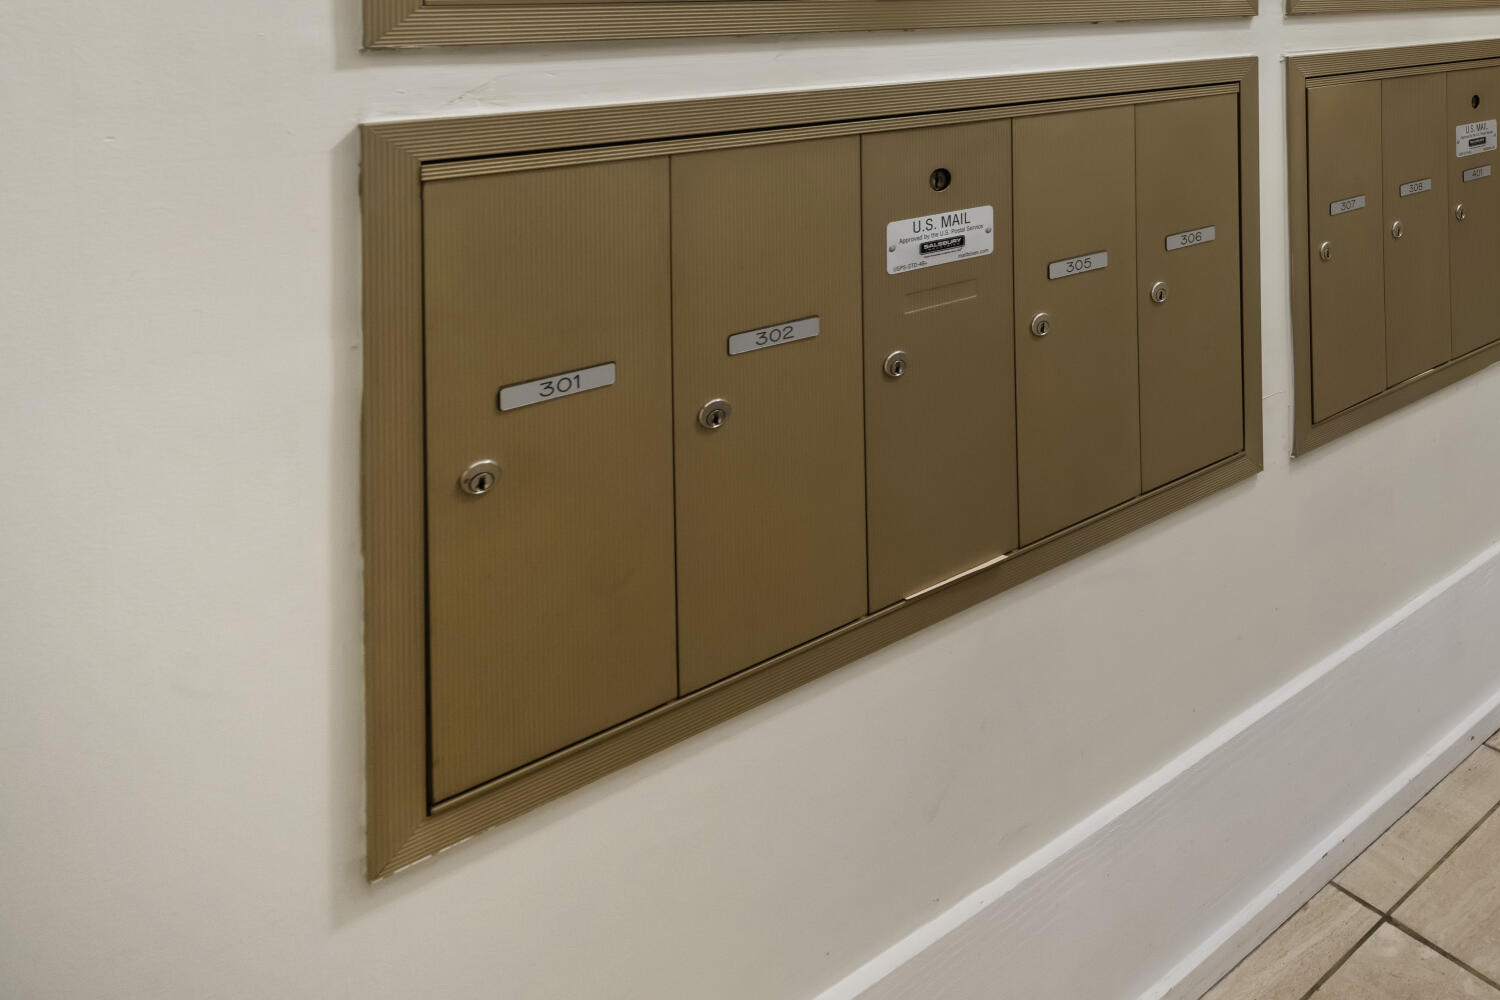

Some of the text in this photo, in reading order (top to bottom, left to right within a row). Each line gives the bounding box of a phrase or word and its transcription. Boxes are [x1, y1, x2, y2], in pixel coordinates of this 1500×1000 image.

[1471, 168, 1484, 177] 401
[1408, 182, 1423, 193] 308
[1340, 199, 1356, 211] 307
[912, 211, 971, 234] U.S. MAIL
[899, 234, 923, 245] Approved
[1180, 231, 1202, 246] 306
[1065, 257, 1092, 273] 305
[754, 326, 795, 346] 302
[538, 374, 582, 398] 301
